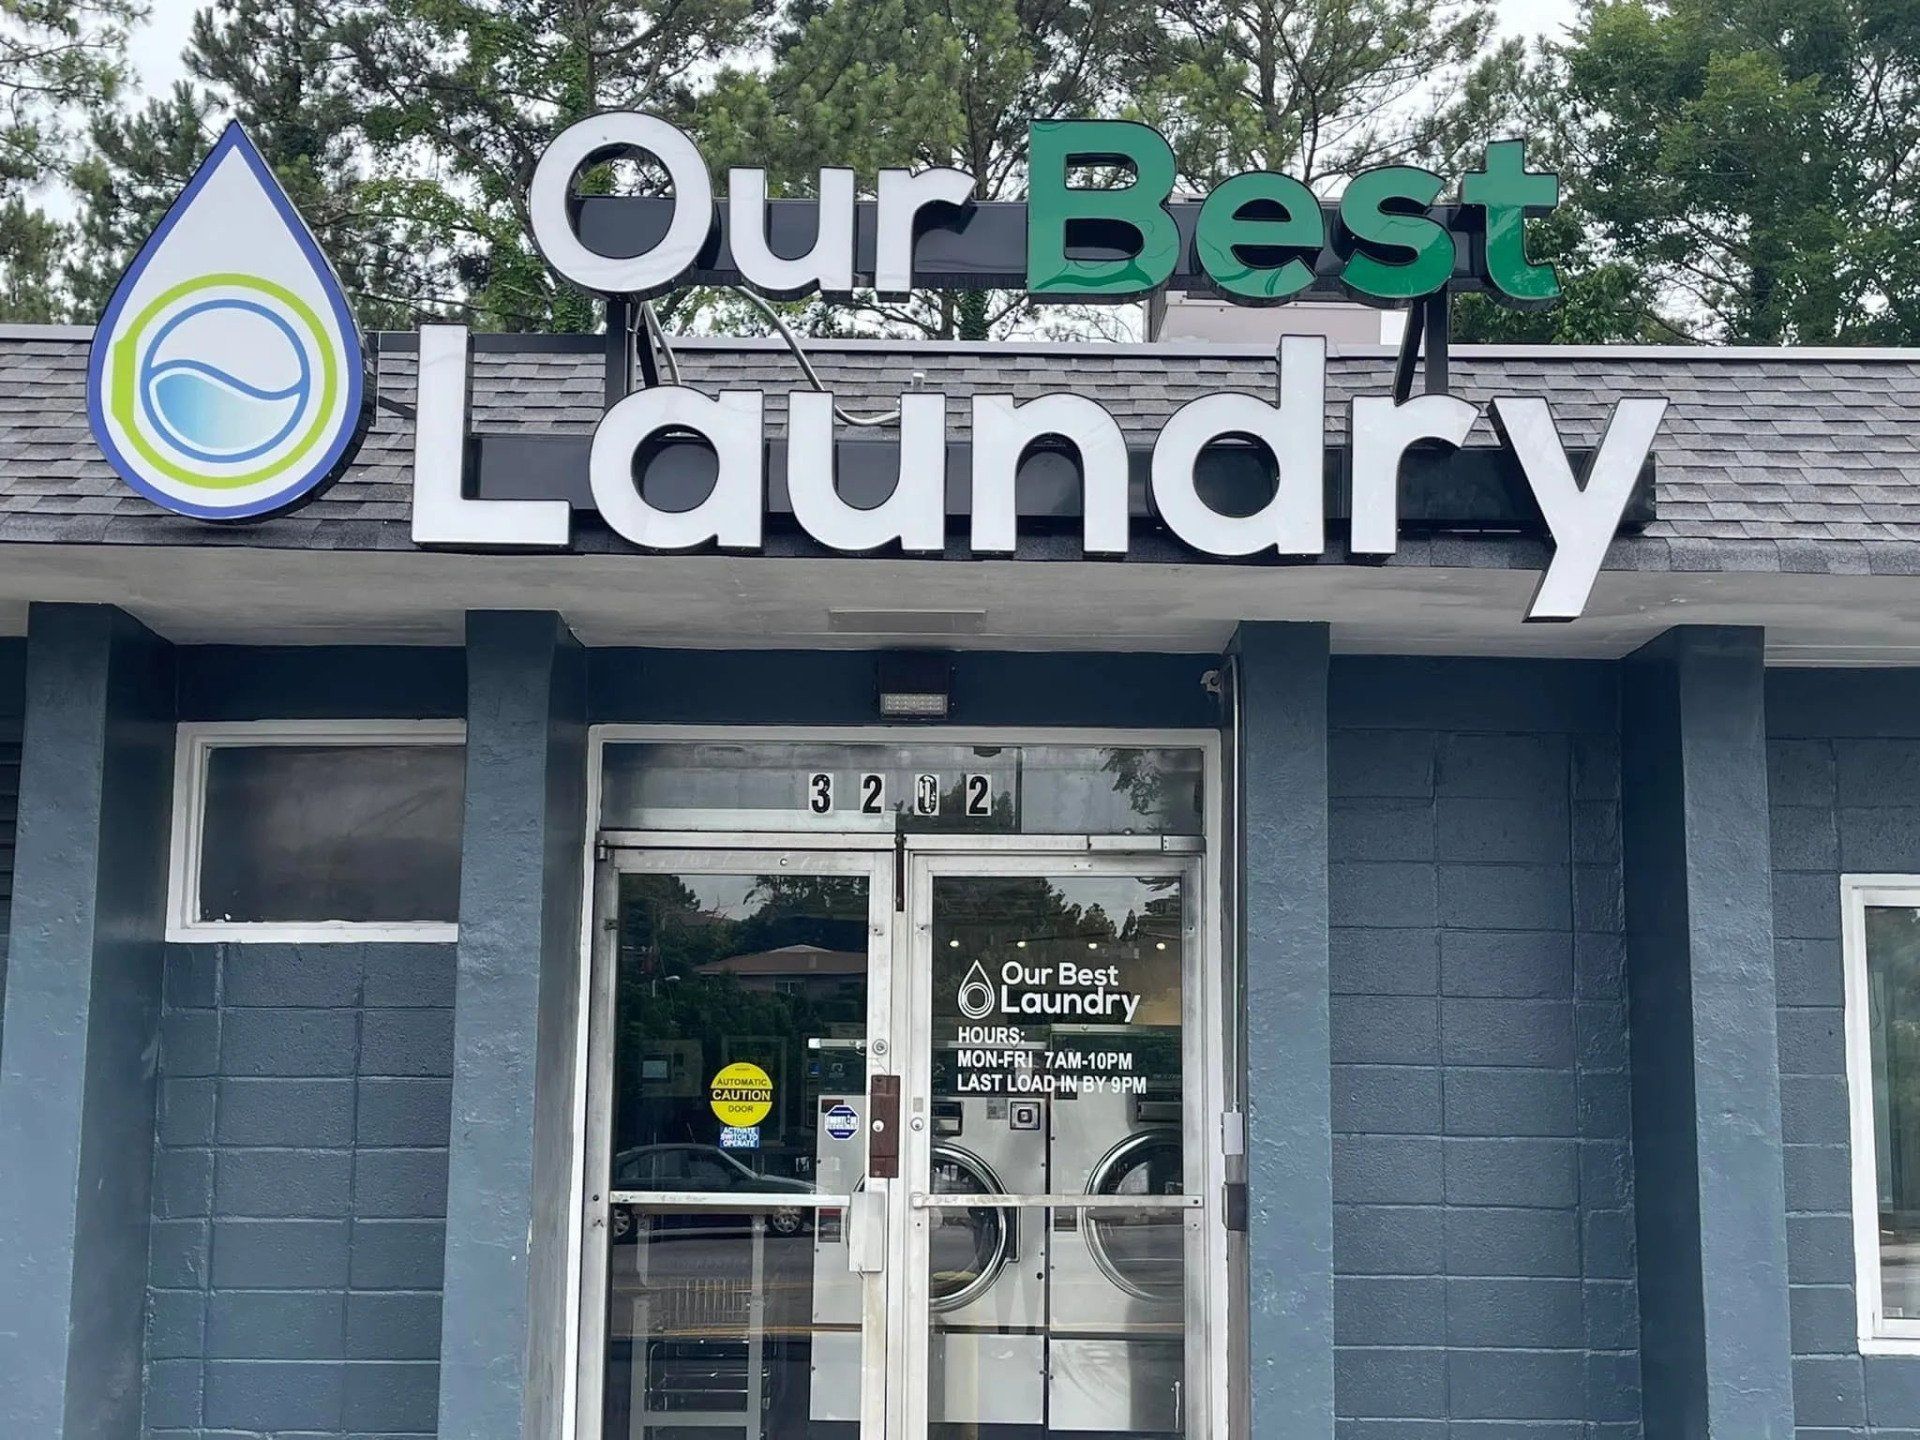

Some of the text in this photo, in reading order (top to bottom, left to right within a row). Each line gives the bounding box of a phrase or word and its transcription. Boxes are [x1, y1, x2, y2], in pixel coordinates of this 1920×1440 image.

[530, 111, 1560, 299] Our Best
[411, 323, 1668, 622] Laundry
[1001, 961, 1119, 986] Our Best
[1001, 985, 1140, 1022] Laundry
[958, 1027, 1025, 1044] HOURS:
[958, 1050, 1132, 1070] MON-FRI 7AM-10PM
[717, 1078, 767, 1086] AUTOMATIC
[958, 1074, 1147, 1094] LAST LOAD IN BY 9PM
[712, 1089, 771, 1100] CAUTION
[728, 1105, 754, 1113] DOOR
